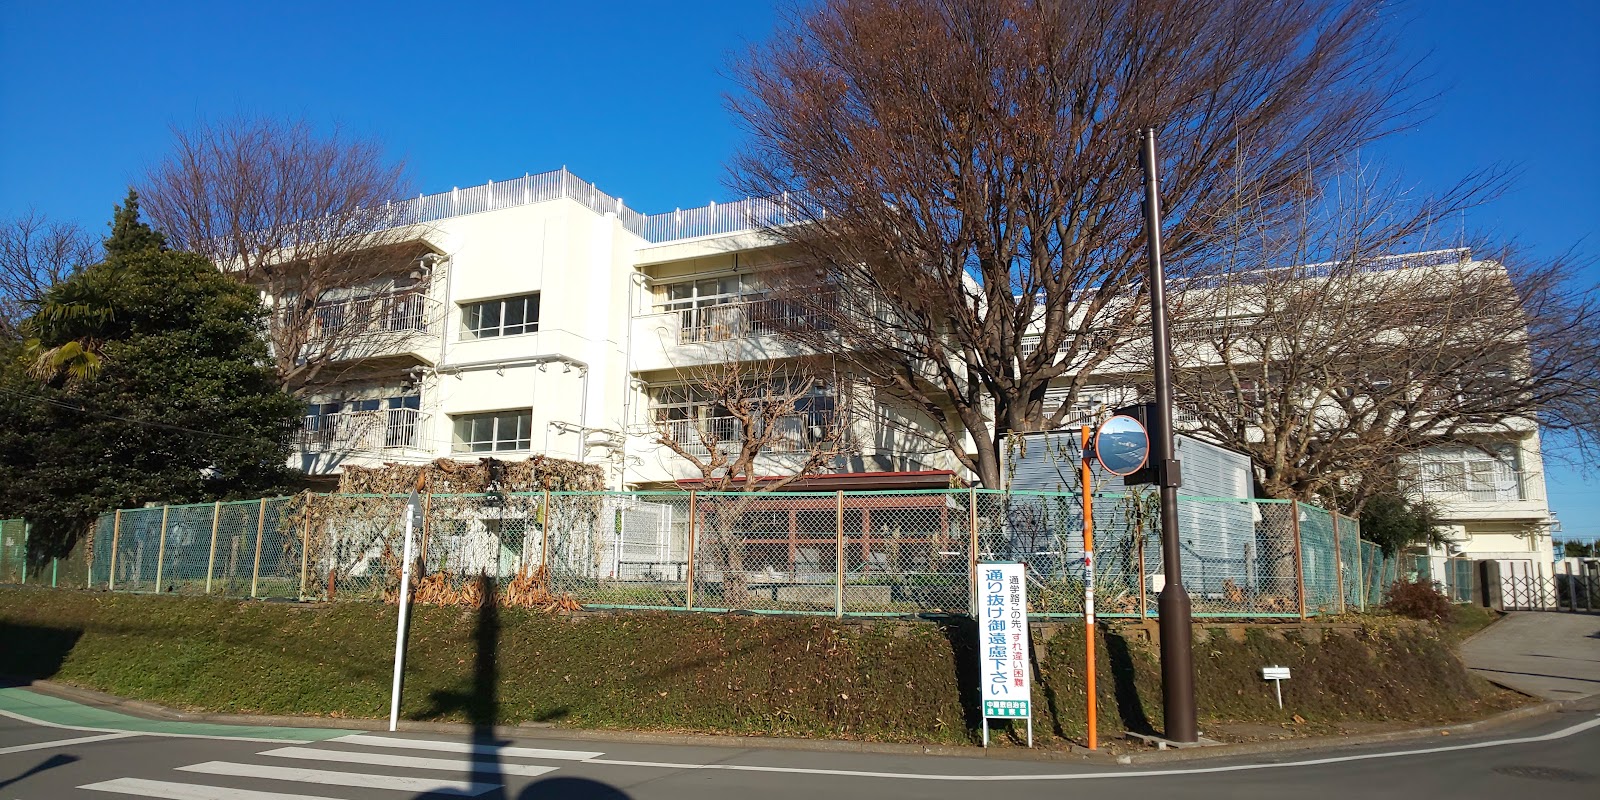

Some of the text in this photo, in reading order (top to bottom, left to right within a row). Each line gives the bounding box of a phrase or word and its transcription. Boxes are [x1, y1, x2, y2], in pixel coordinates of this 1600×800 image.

[985, 569, 1009, 696] 通り抜け御遠慮下さい
